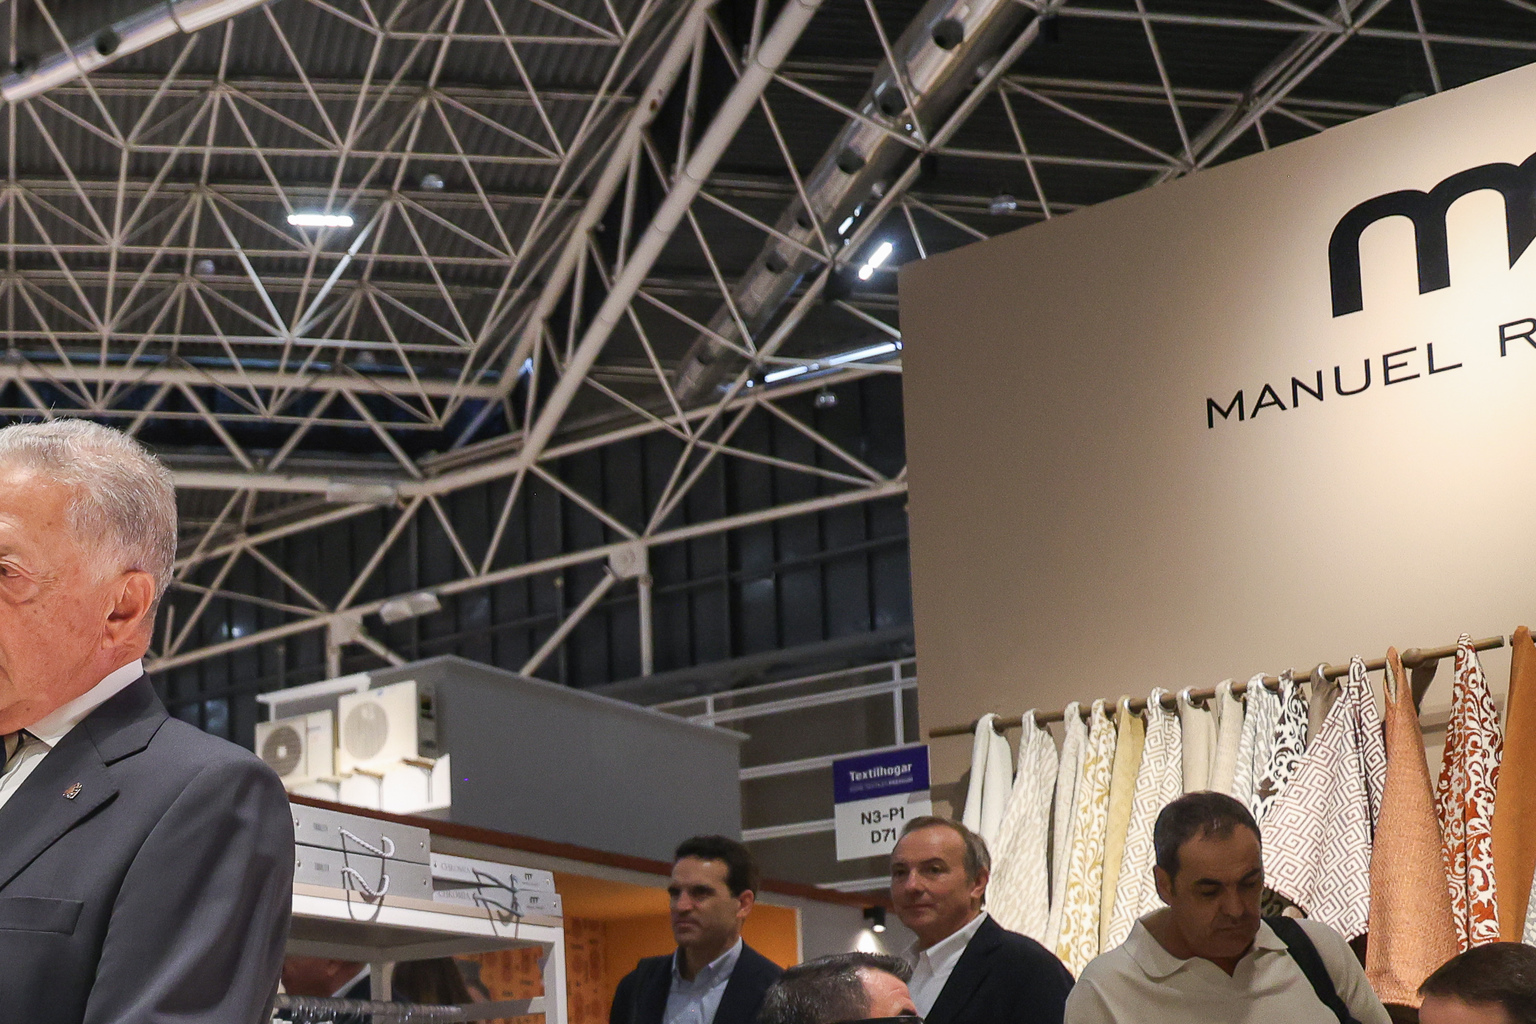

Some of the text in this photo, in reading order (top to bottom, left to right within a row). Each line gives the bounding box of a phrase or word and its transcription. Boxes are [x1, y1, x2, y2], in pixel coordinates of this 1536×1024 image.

[1206, 342, 1463, 429] MANUEL
[849, 763, 913, 782] Textilhogar
[861, 806, 905, 825] N3-P1
[871, 828, 897, 844] D71
